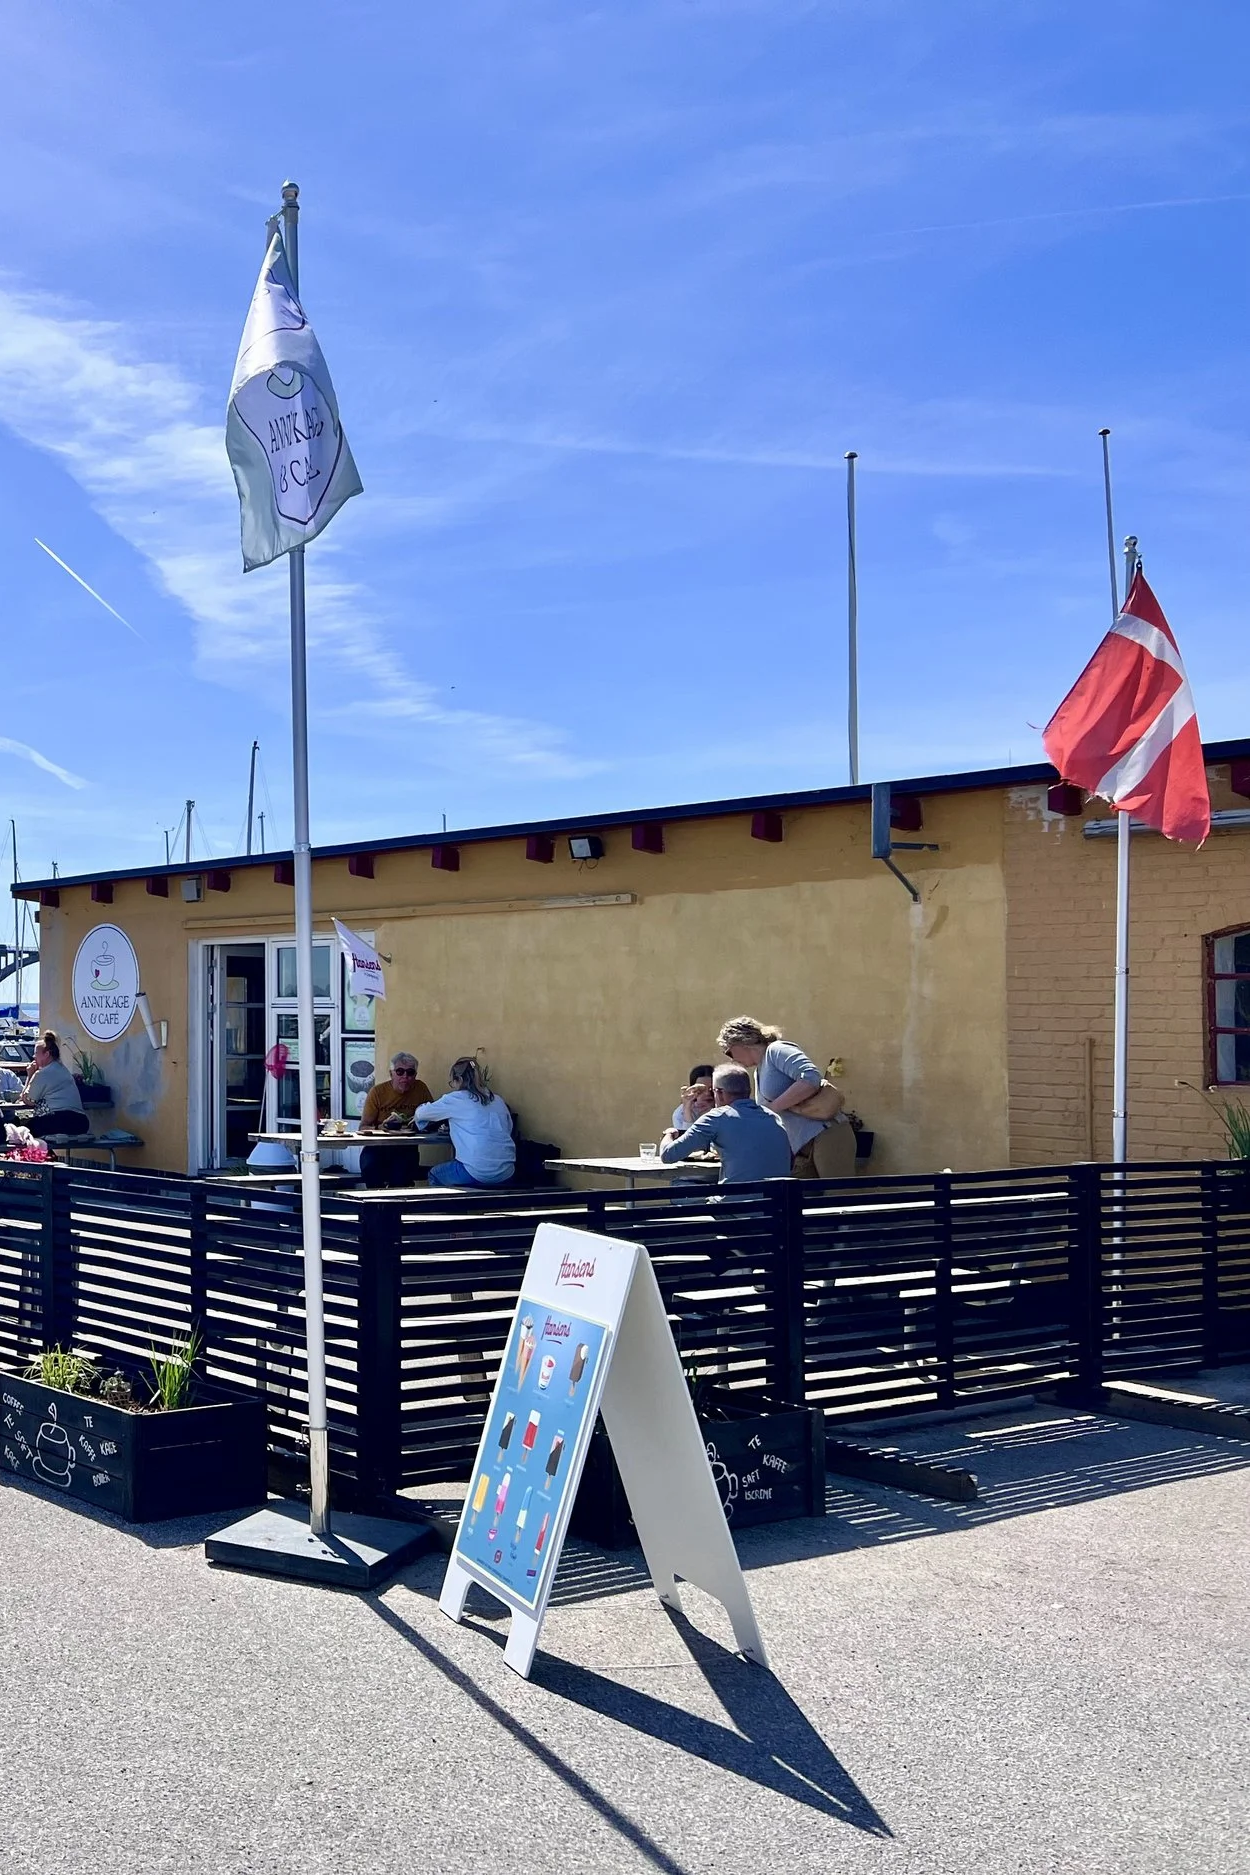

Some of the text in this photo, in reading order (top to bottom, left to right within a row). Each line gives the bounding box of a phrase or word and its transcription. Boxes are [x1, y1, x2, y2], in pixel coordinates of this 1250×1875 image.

[98, 1010, 120, 1025] CAFÉ
[555, 1252, 598, 1287] Hansens
[540, 1314, 572, 1341] Hansens
[3, 1413, 15, 1430] TE
[83, 1415, 94, 1428] TE
[747, 1434, 762, 1450] TE
[762, 1453, 788, 1474] KAFFE
[741, 1468, 761, 1488] SAFT
